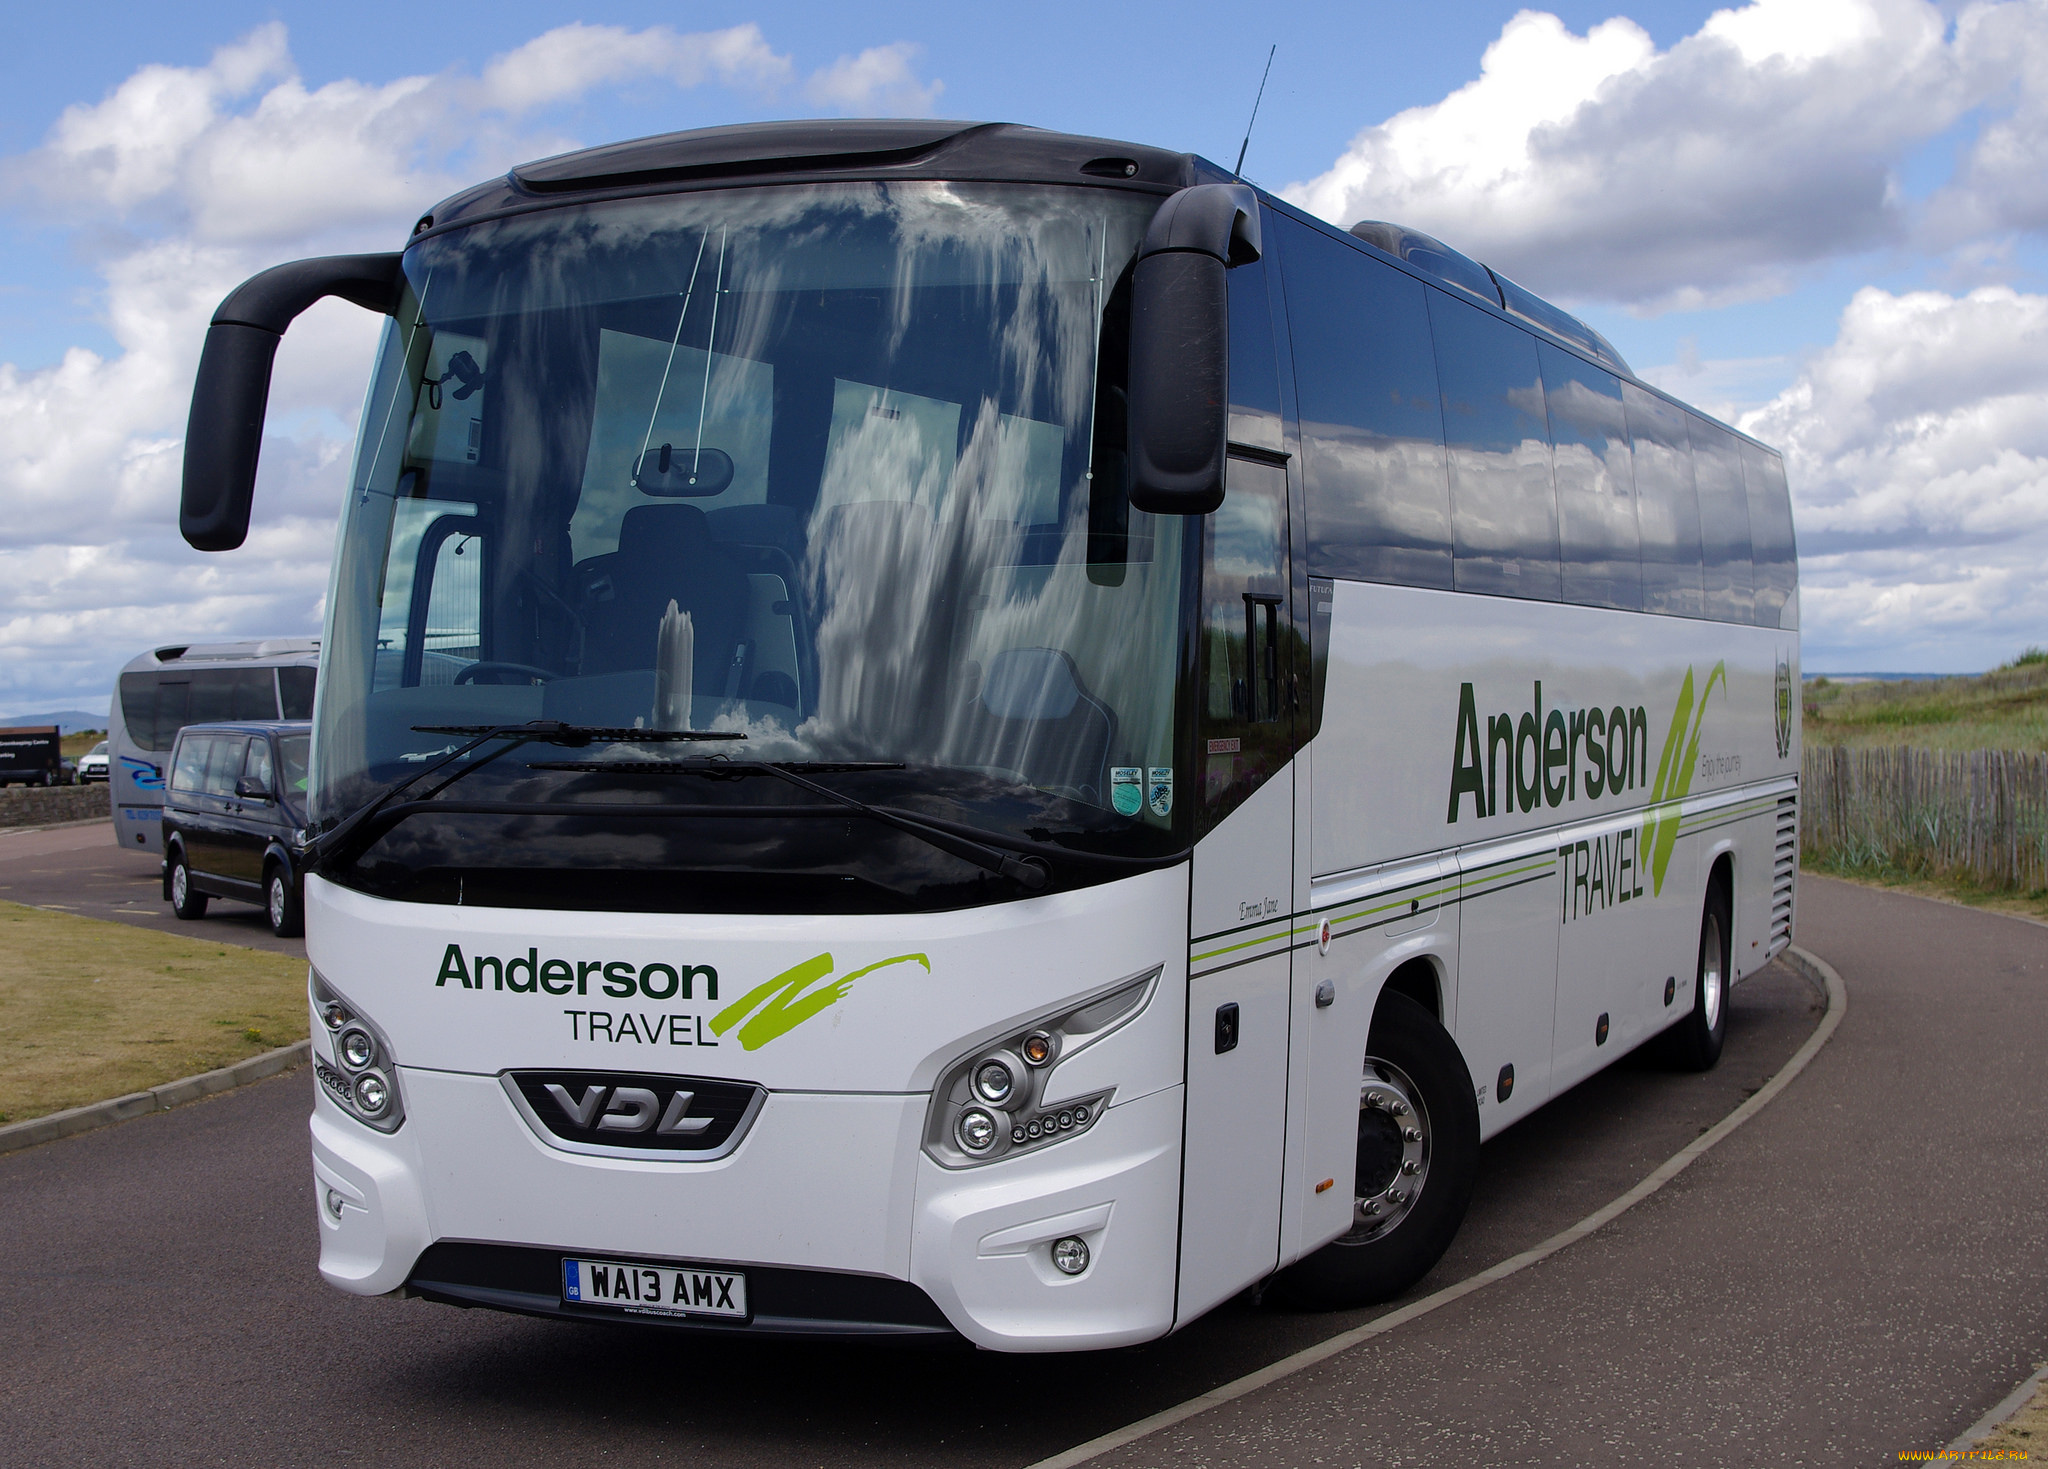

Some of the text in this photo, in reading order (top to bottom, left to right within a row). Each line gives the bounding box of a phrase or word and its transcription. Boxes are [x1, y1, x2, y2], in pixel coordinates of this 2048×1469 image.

[1309, 584, 1333, 595] FUTURA
[1208, 739, 1239, 753] EMERGENCY EXIT
[1447, 680, 1648, 824] Anderson
[1701, 754, 1715, 782] Enjoy
[1716, 751, 1724, 775] the
[1558, 827, 1643, 925] TRAVEL
[1239, 896, 1278, 921] Emma Jane
[435, 943, 719, 1001] Anderson
[563, 1009, 719, 1047] TRAVEL
[543, 1083, 715, 1135] VDL
[568, 1286, 580, 1296] GB
[590, 1265, 736, 1310] WA13 AMX
[623, 1307, 687, 1318] www.vdlbuscoach.com
